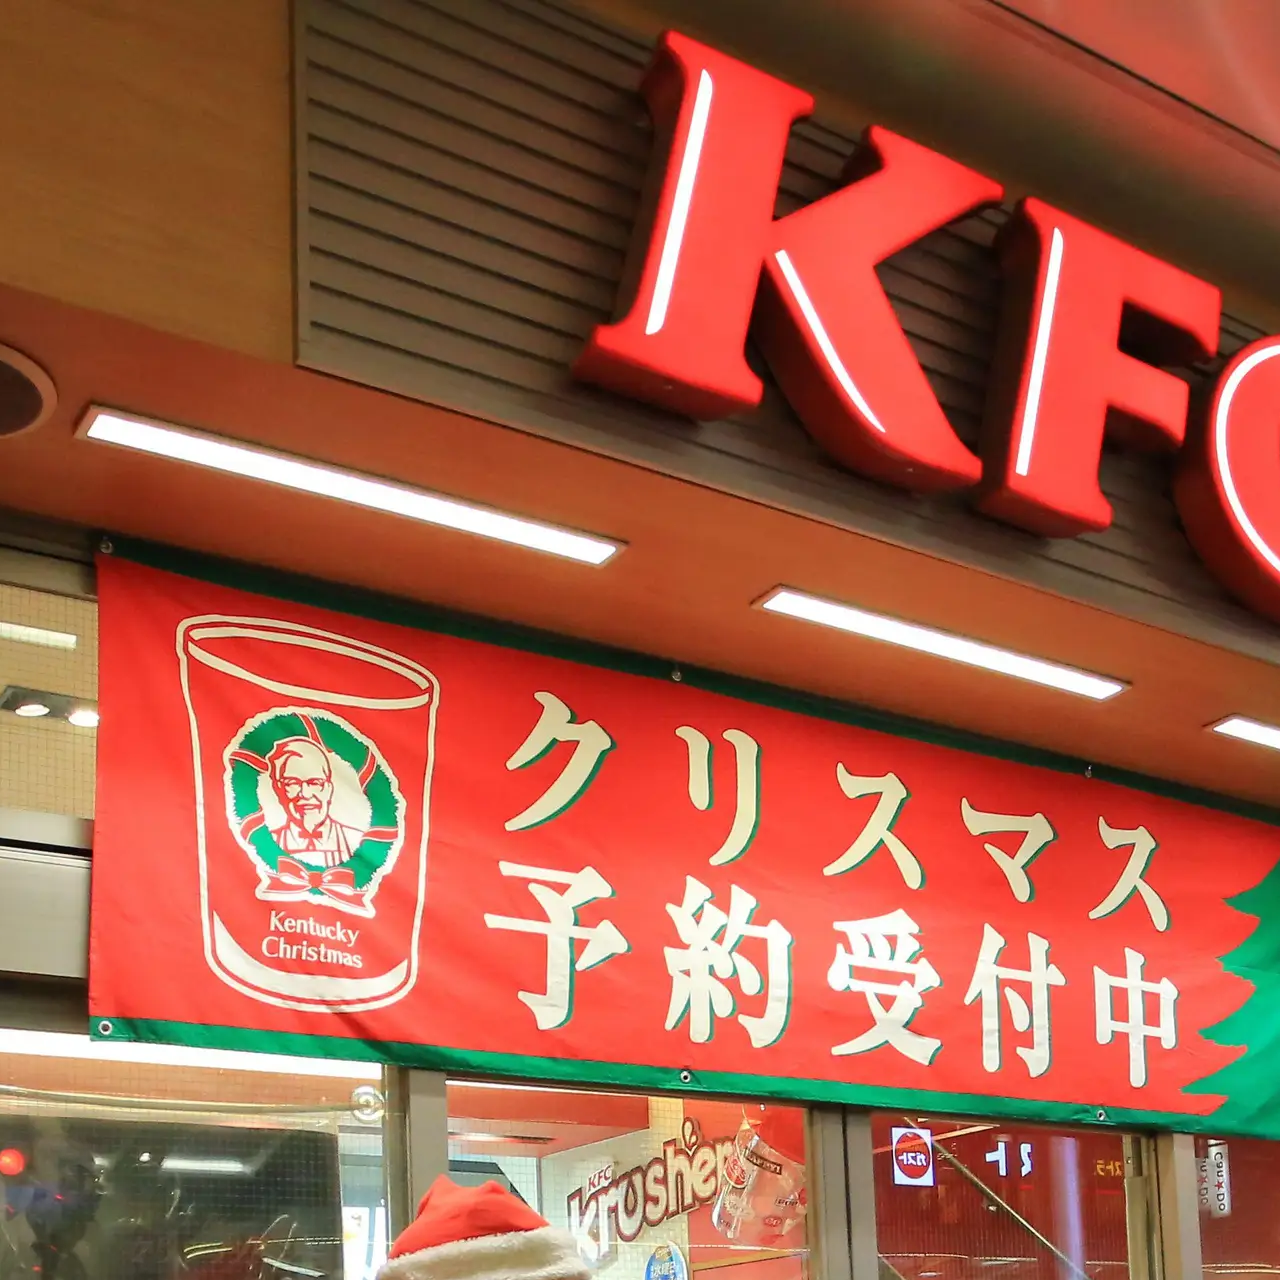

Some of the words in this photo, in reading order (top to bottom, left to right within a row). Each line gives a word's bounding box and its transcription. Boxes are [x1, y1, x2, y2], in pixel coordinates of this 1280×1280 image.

[504, 690, 1171, 932] クリスマス
[260, 936, 364, 970] Christmas
[268, 910, 360, 947] Kentucky
[483, 859, 1180, 1089] 予約受付中
